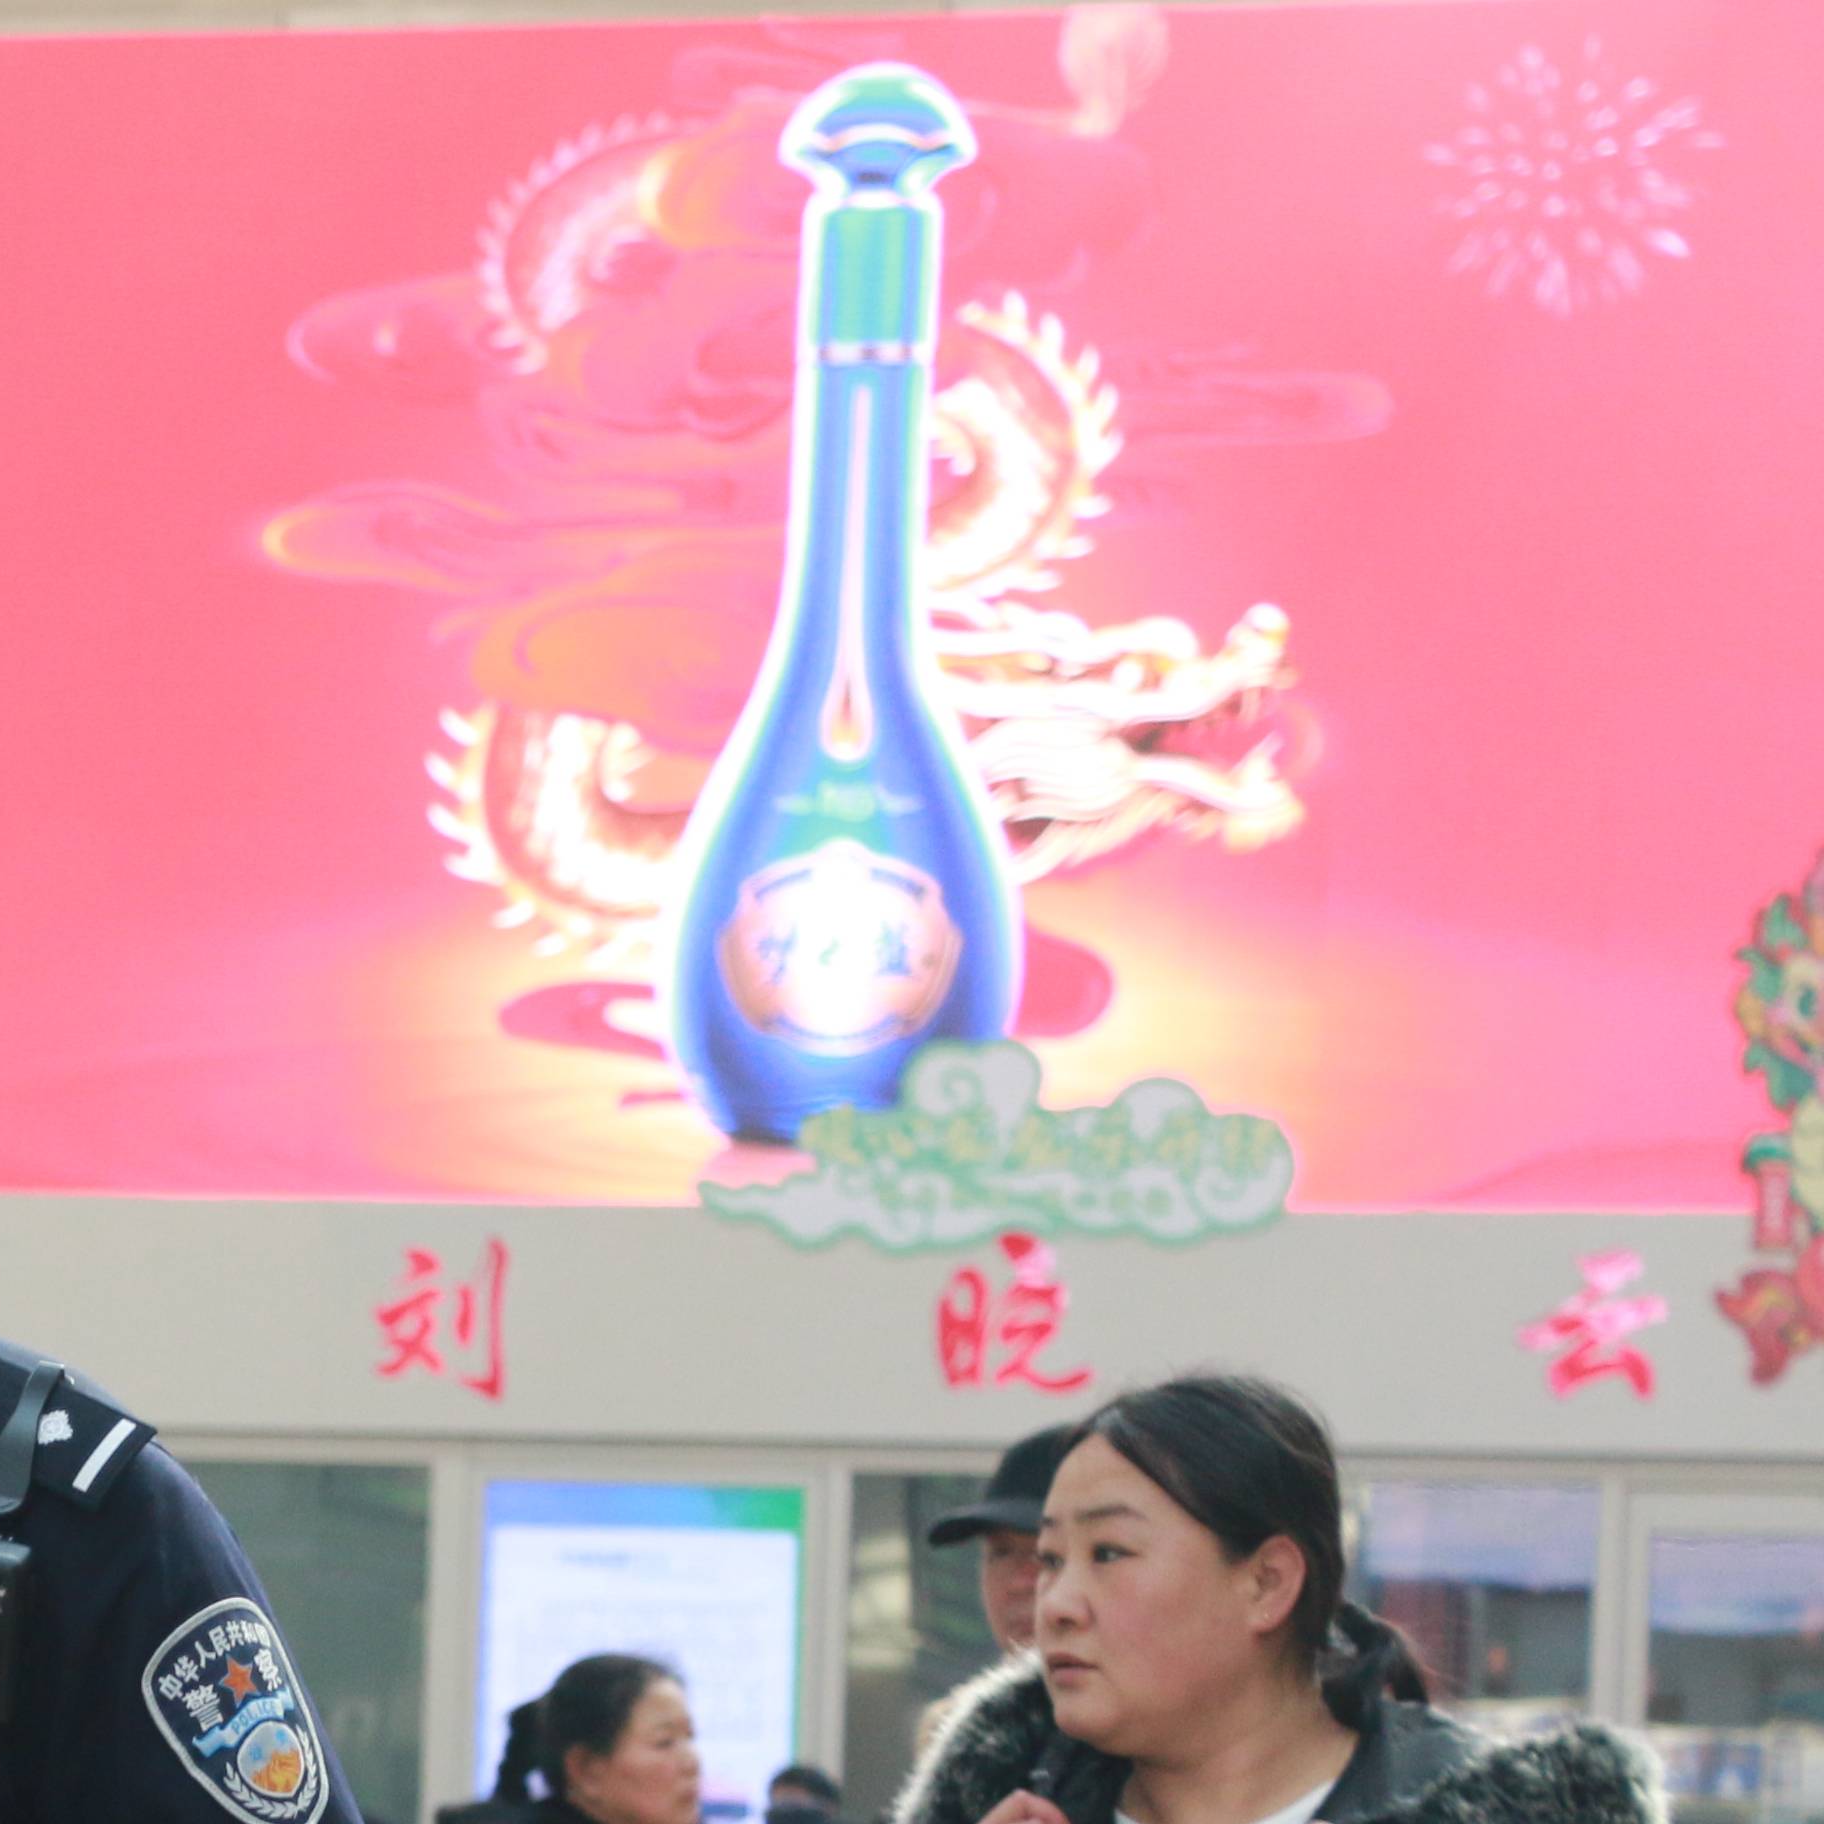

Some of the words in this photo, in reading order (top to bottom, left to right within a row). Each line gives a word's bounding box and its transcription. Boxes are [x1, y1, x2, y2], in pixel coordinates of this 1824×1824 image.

[157, 1619, 272, 1701] 中华人民共和国
[231, 1697, 283, 1735] POLICE
